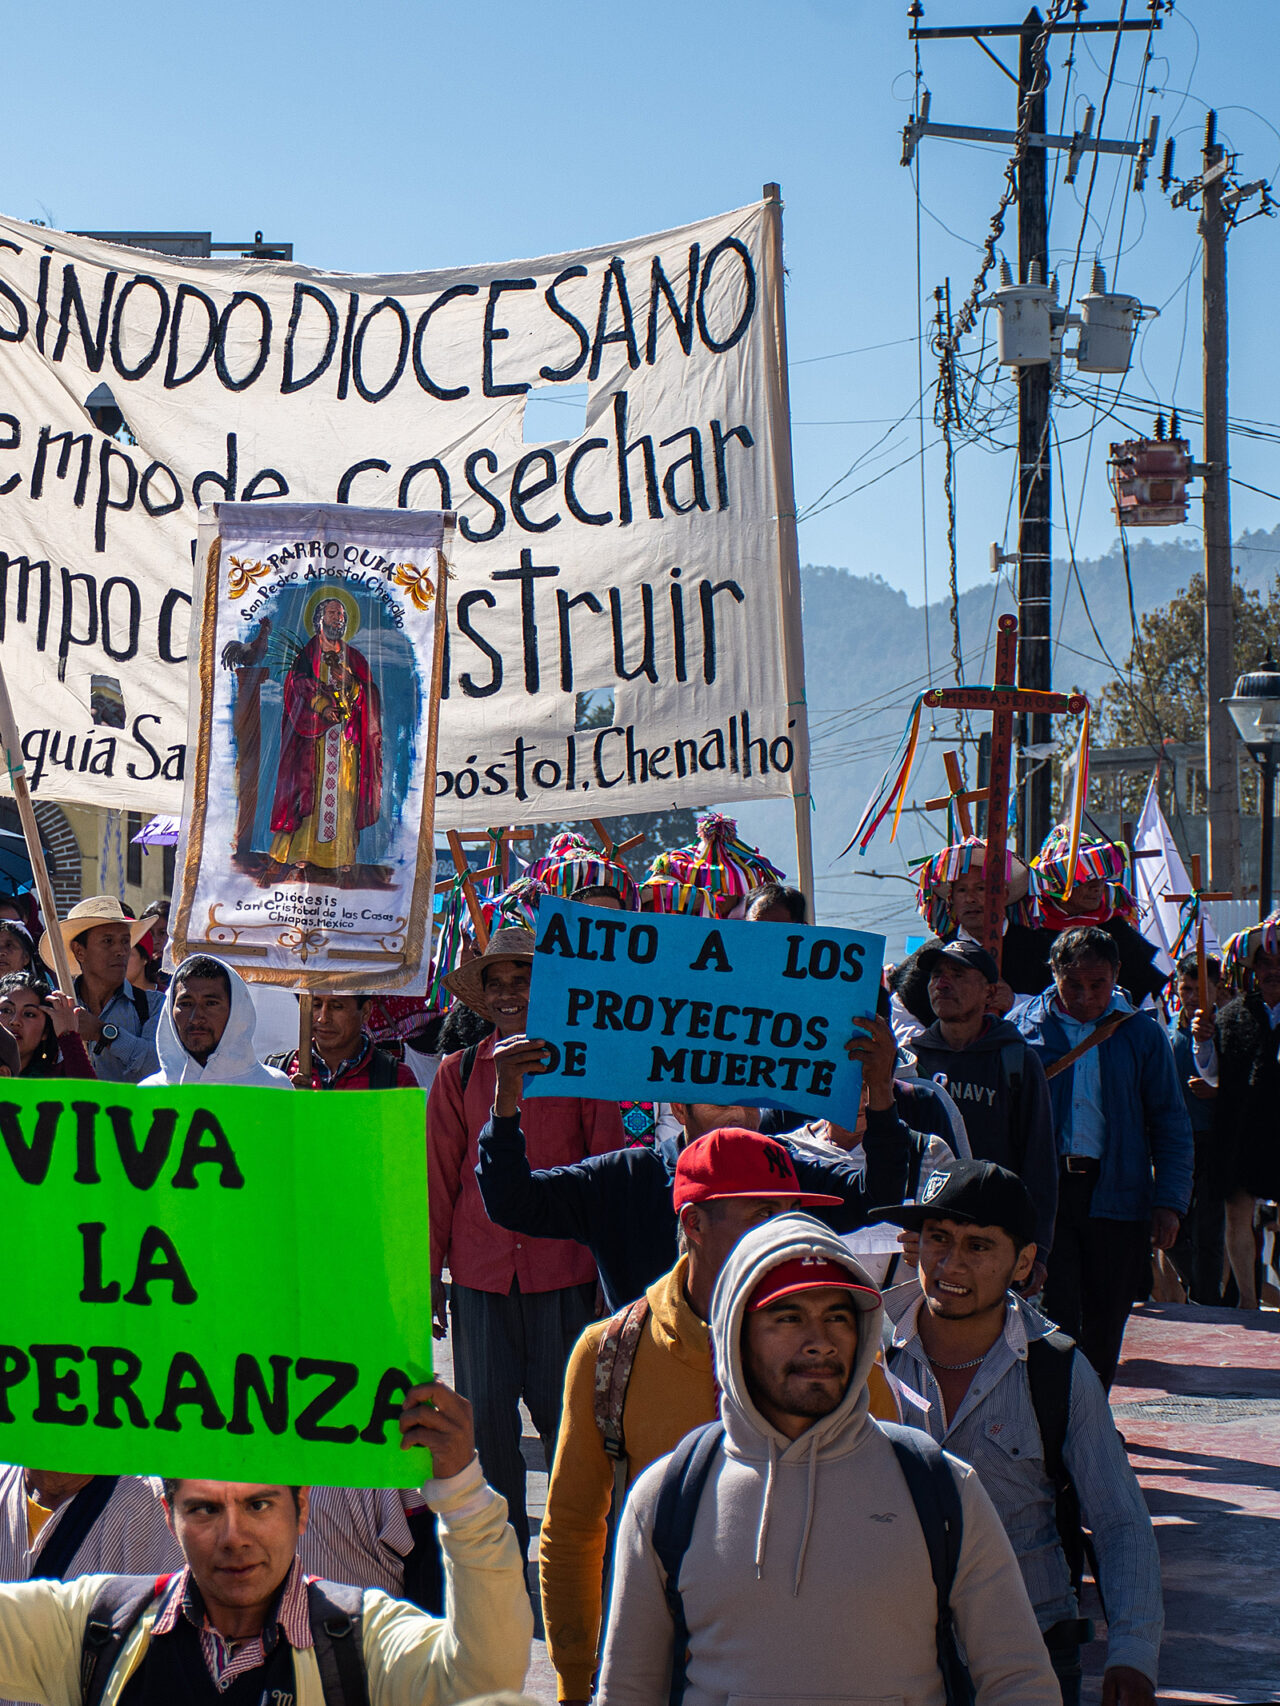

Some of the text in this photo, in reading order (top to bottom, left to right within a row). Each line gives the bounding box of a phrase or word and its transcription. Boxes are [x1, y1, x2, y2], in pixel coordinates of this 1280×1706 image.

[281, 237, 756, 403] DIOCESANO
[240, 597, 263, 621] San
[258, 571, 299, 599] Pedro
[945, 691, 1057, 710] MENSAJEROS
[594, 710, 797, 789] Chenalhó
[235, 900, 394, 922] San Cristóbal de las Casas
[274, 891, 338, 907] Diócesis
[535, 912, 866, 983] ALTO A LOS
[566, 987, 830, 1051] PROYECTOS
[647, 1045, 837, 1098] MUERTE
[950, 1081, 997, 1107] NAVY
[77, 1222, 199, 1305] LA
